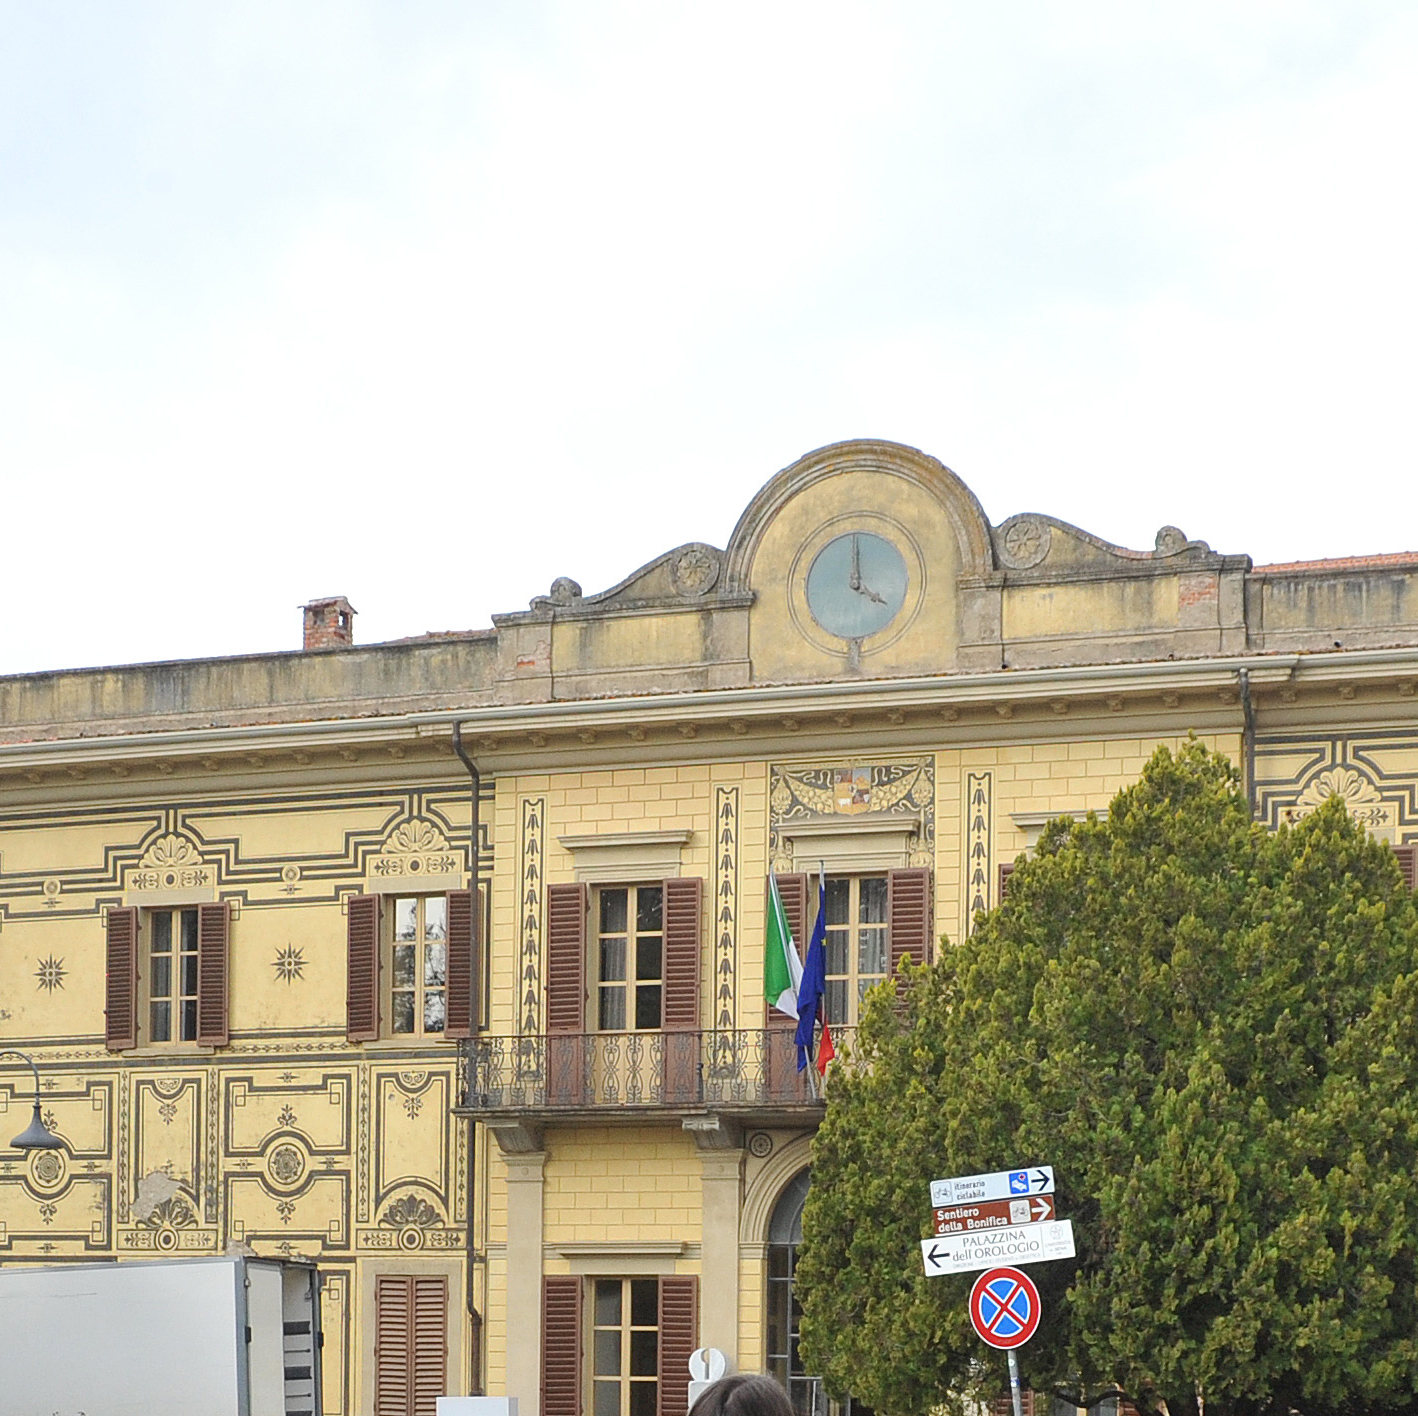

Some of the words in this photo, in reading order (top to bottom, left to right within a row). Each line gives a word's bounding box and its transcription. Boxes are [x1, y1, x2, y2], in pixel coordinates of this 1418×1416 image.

[957, 1190, 986, 1200] ciclabile
[937, 1208, 980, 1221] Sentiero
[938, 1221, 963, 1233] della
[967, 1216, 1008, 1229] Bonifica
[962, 1230, 1026, 1248] PALAZZINA
